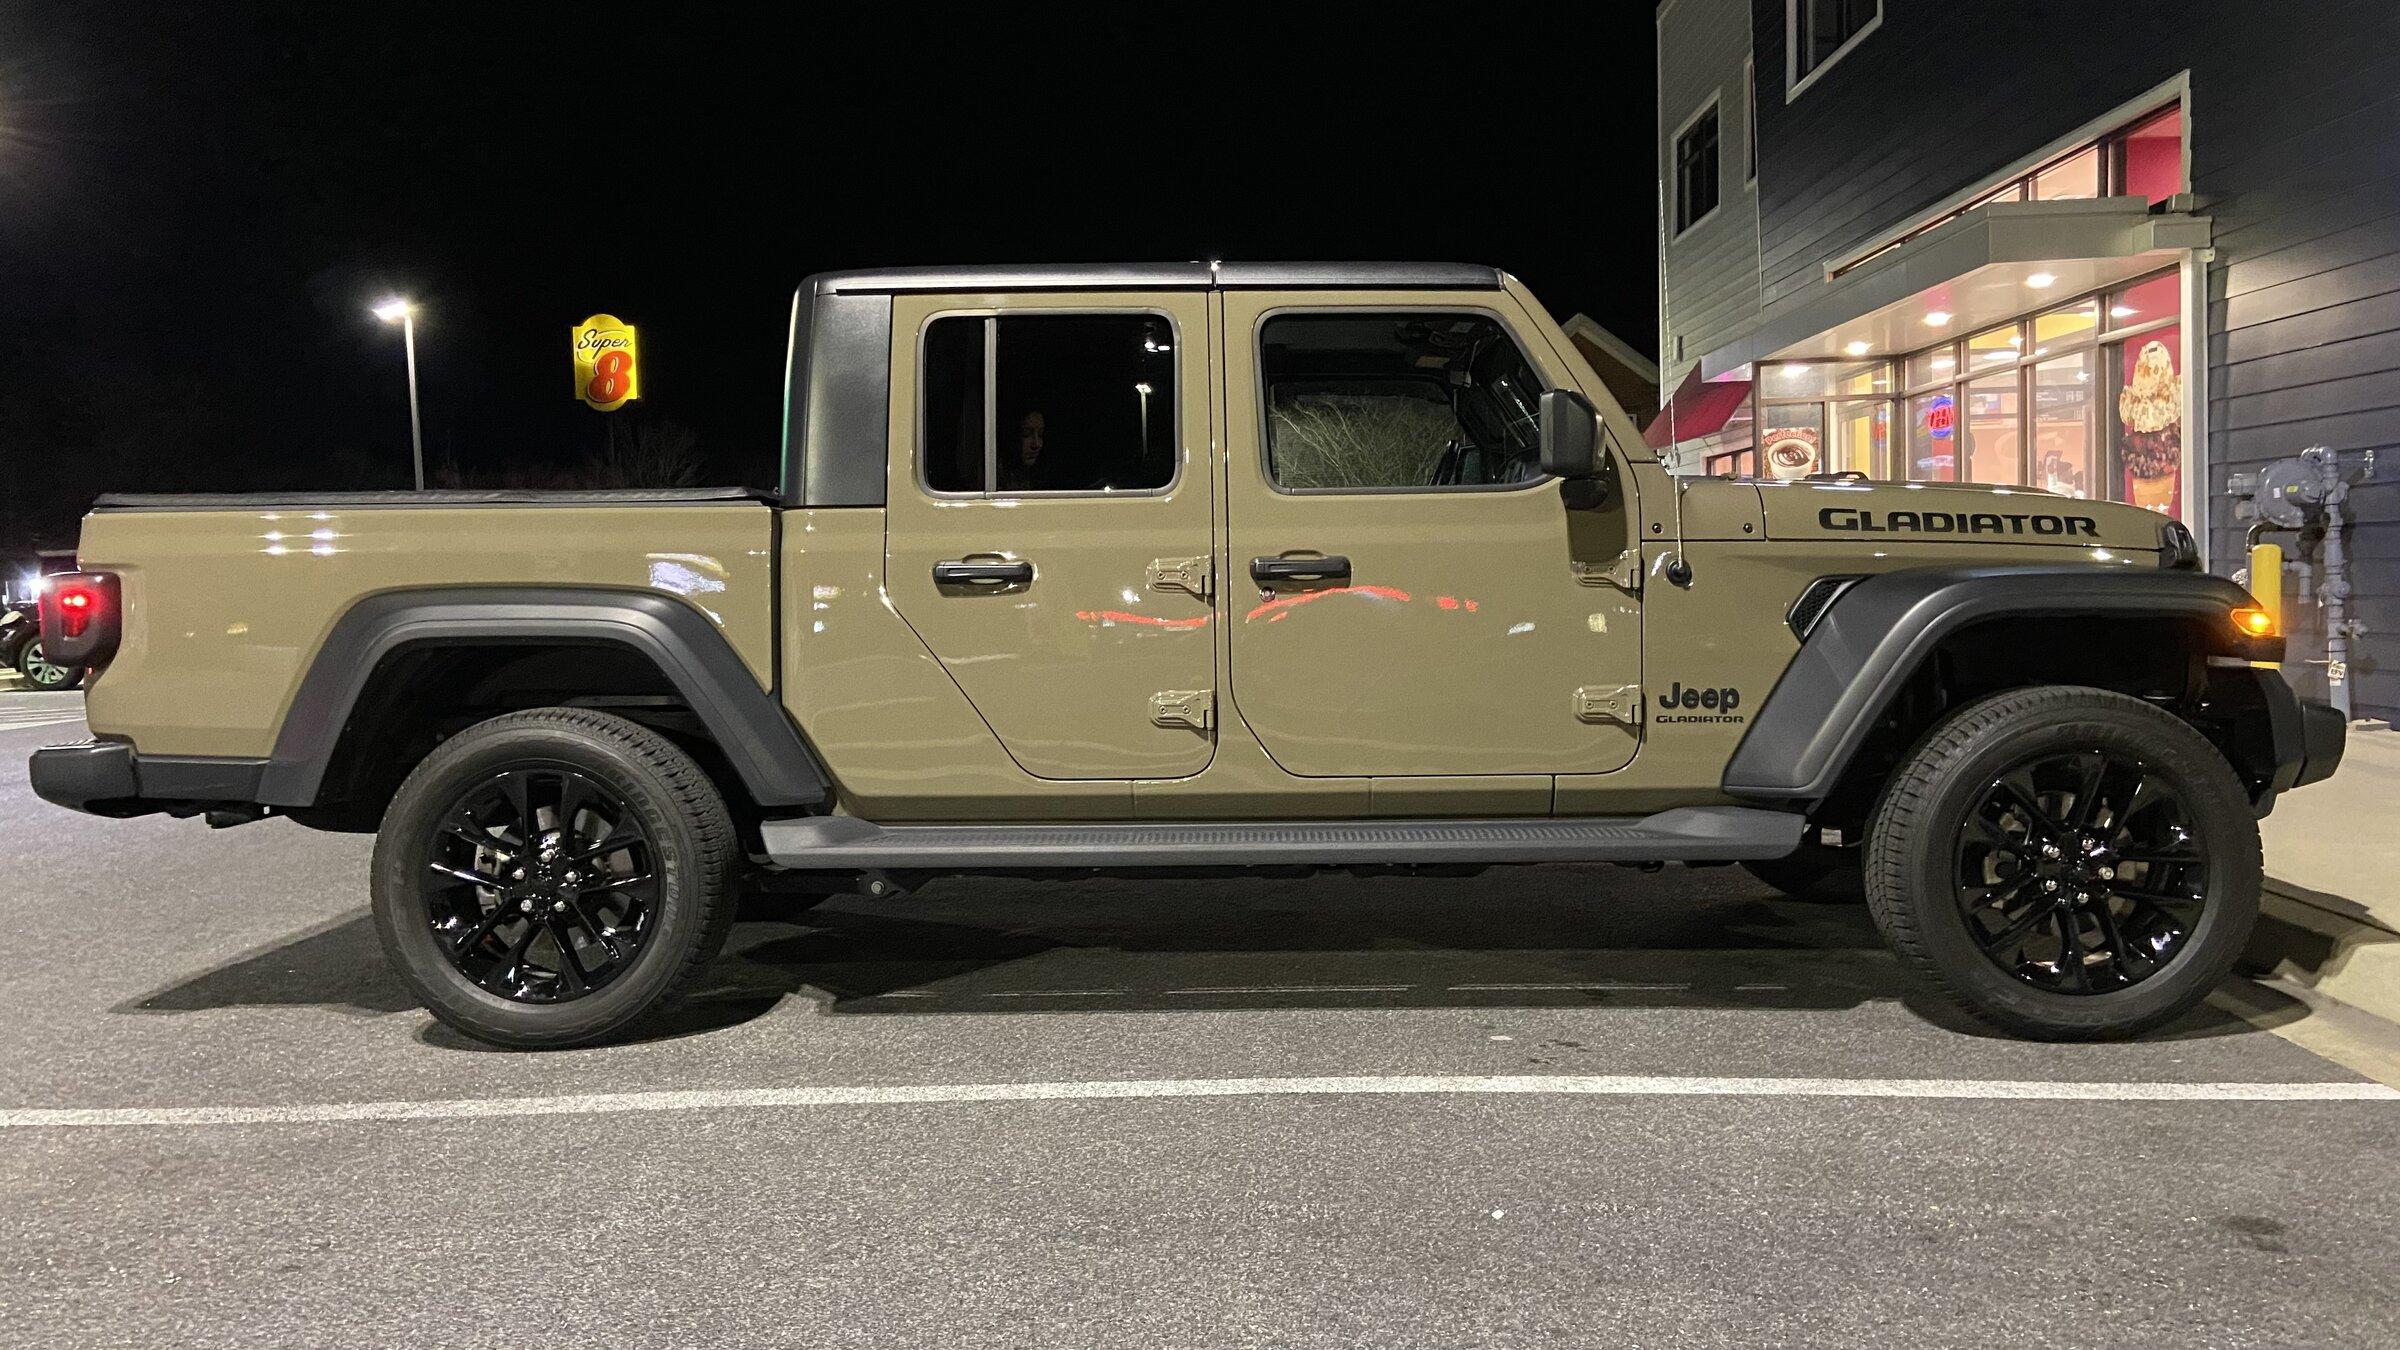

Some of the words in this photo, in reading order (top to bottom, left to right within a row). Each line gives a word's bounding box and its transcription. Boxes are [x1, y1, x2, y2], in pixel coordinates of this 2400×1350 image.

[577, 328, 633, 360] Super
[587, 350, 633, 404] 8
[1818, 507, 2100, 538] GLADIATOR
[1659, 682, 1740, 714] Jeep
[1655, 715, 1744, 724] GLADIATOR
